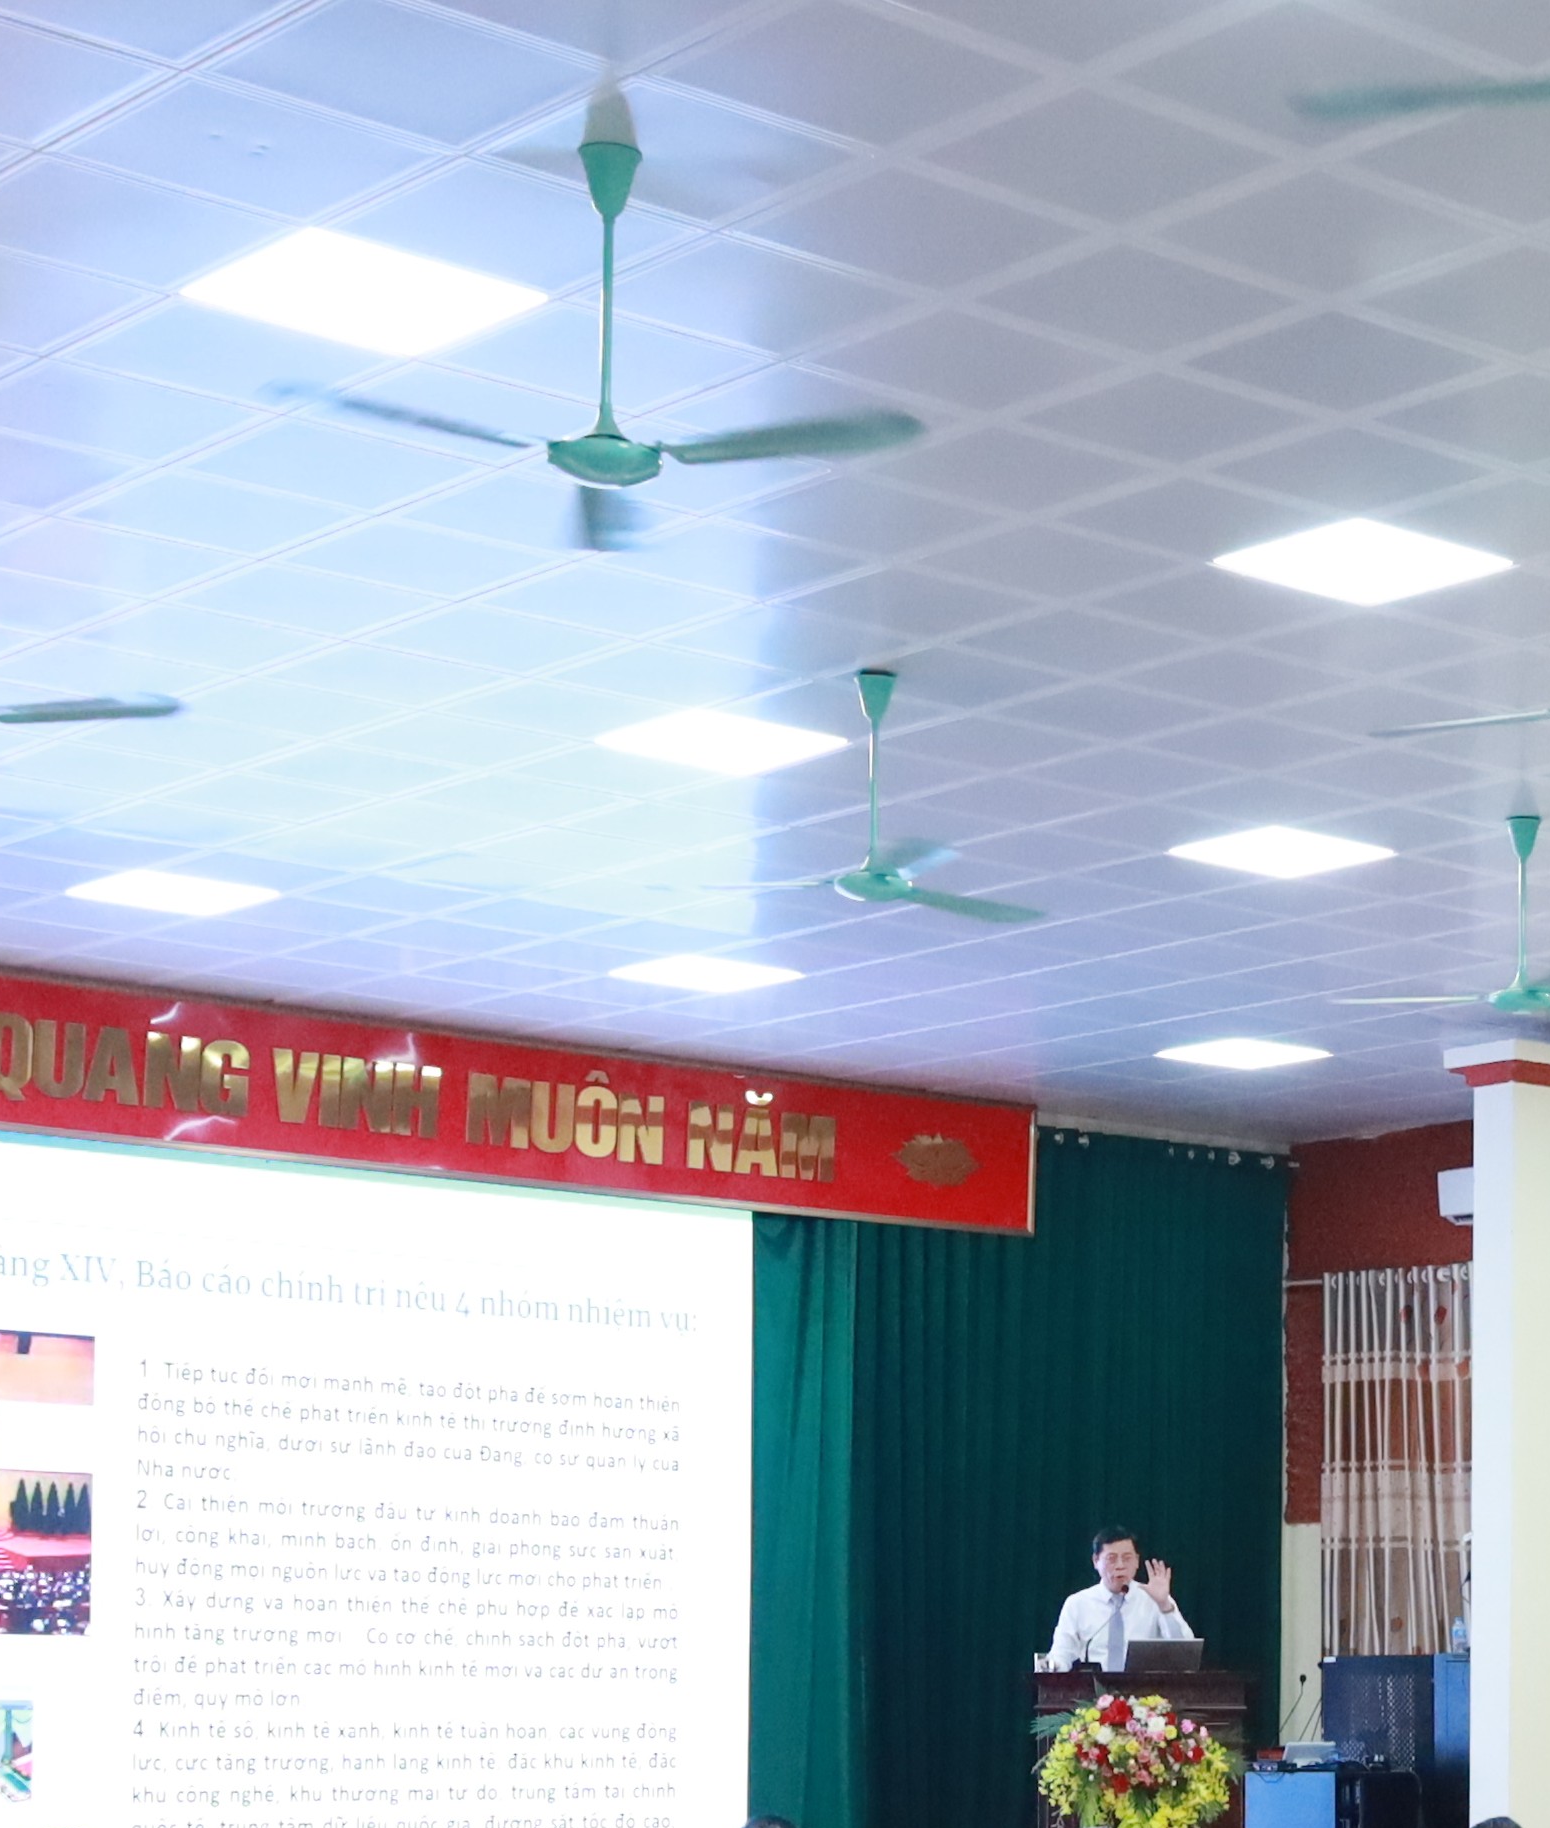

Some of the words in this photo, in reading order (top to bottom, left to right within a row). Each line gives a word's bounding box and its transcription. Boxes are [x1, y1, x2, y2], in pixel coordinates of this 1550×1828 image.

[273, 1048, 440, 1140] VINH
[467, 1071, 664, 1167] MUÔN
[689, 1087, 834, 1181] NĂM
[136, 1260, 191, 1290] Báo
[202, 1264, 250, 1294] cáo
[261, 1270, 343, 1303] chính
[456, 1292, 470, 1317] 4
[481, 1290, 559, 1320] nhóm
